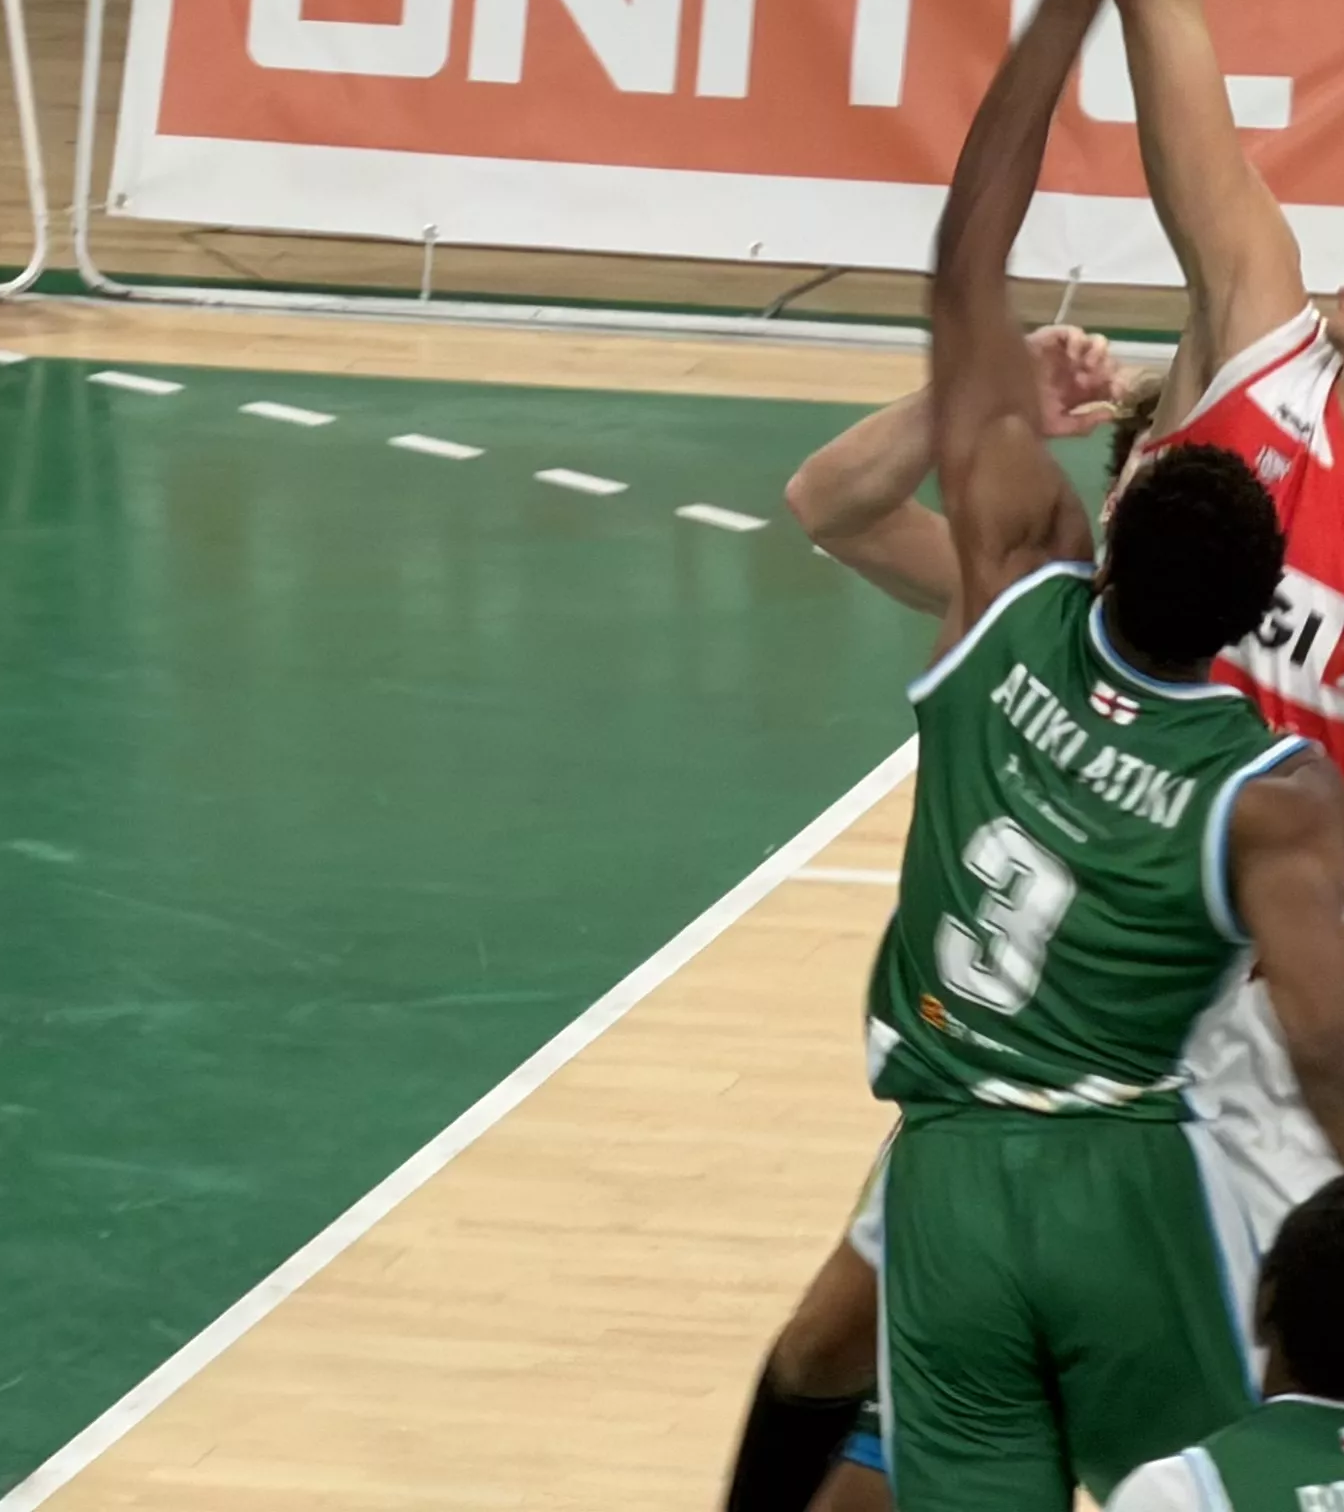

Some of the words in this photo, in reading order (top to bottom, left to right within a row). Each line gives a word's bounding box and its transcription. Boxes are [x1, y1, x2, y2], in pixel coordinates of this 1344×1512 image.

[989, 662, 1090, 771] ATIKI
[1078, 744, 1198, 829] ATIKI
[934, 814, 1077, 1017] 3
